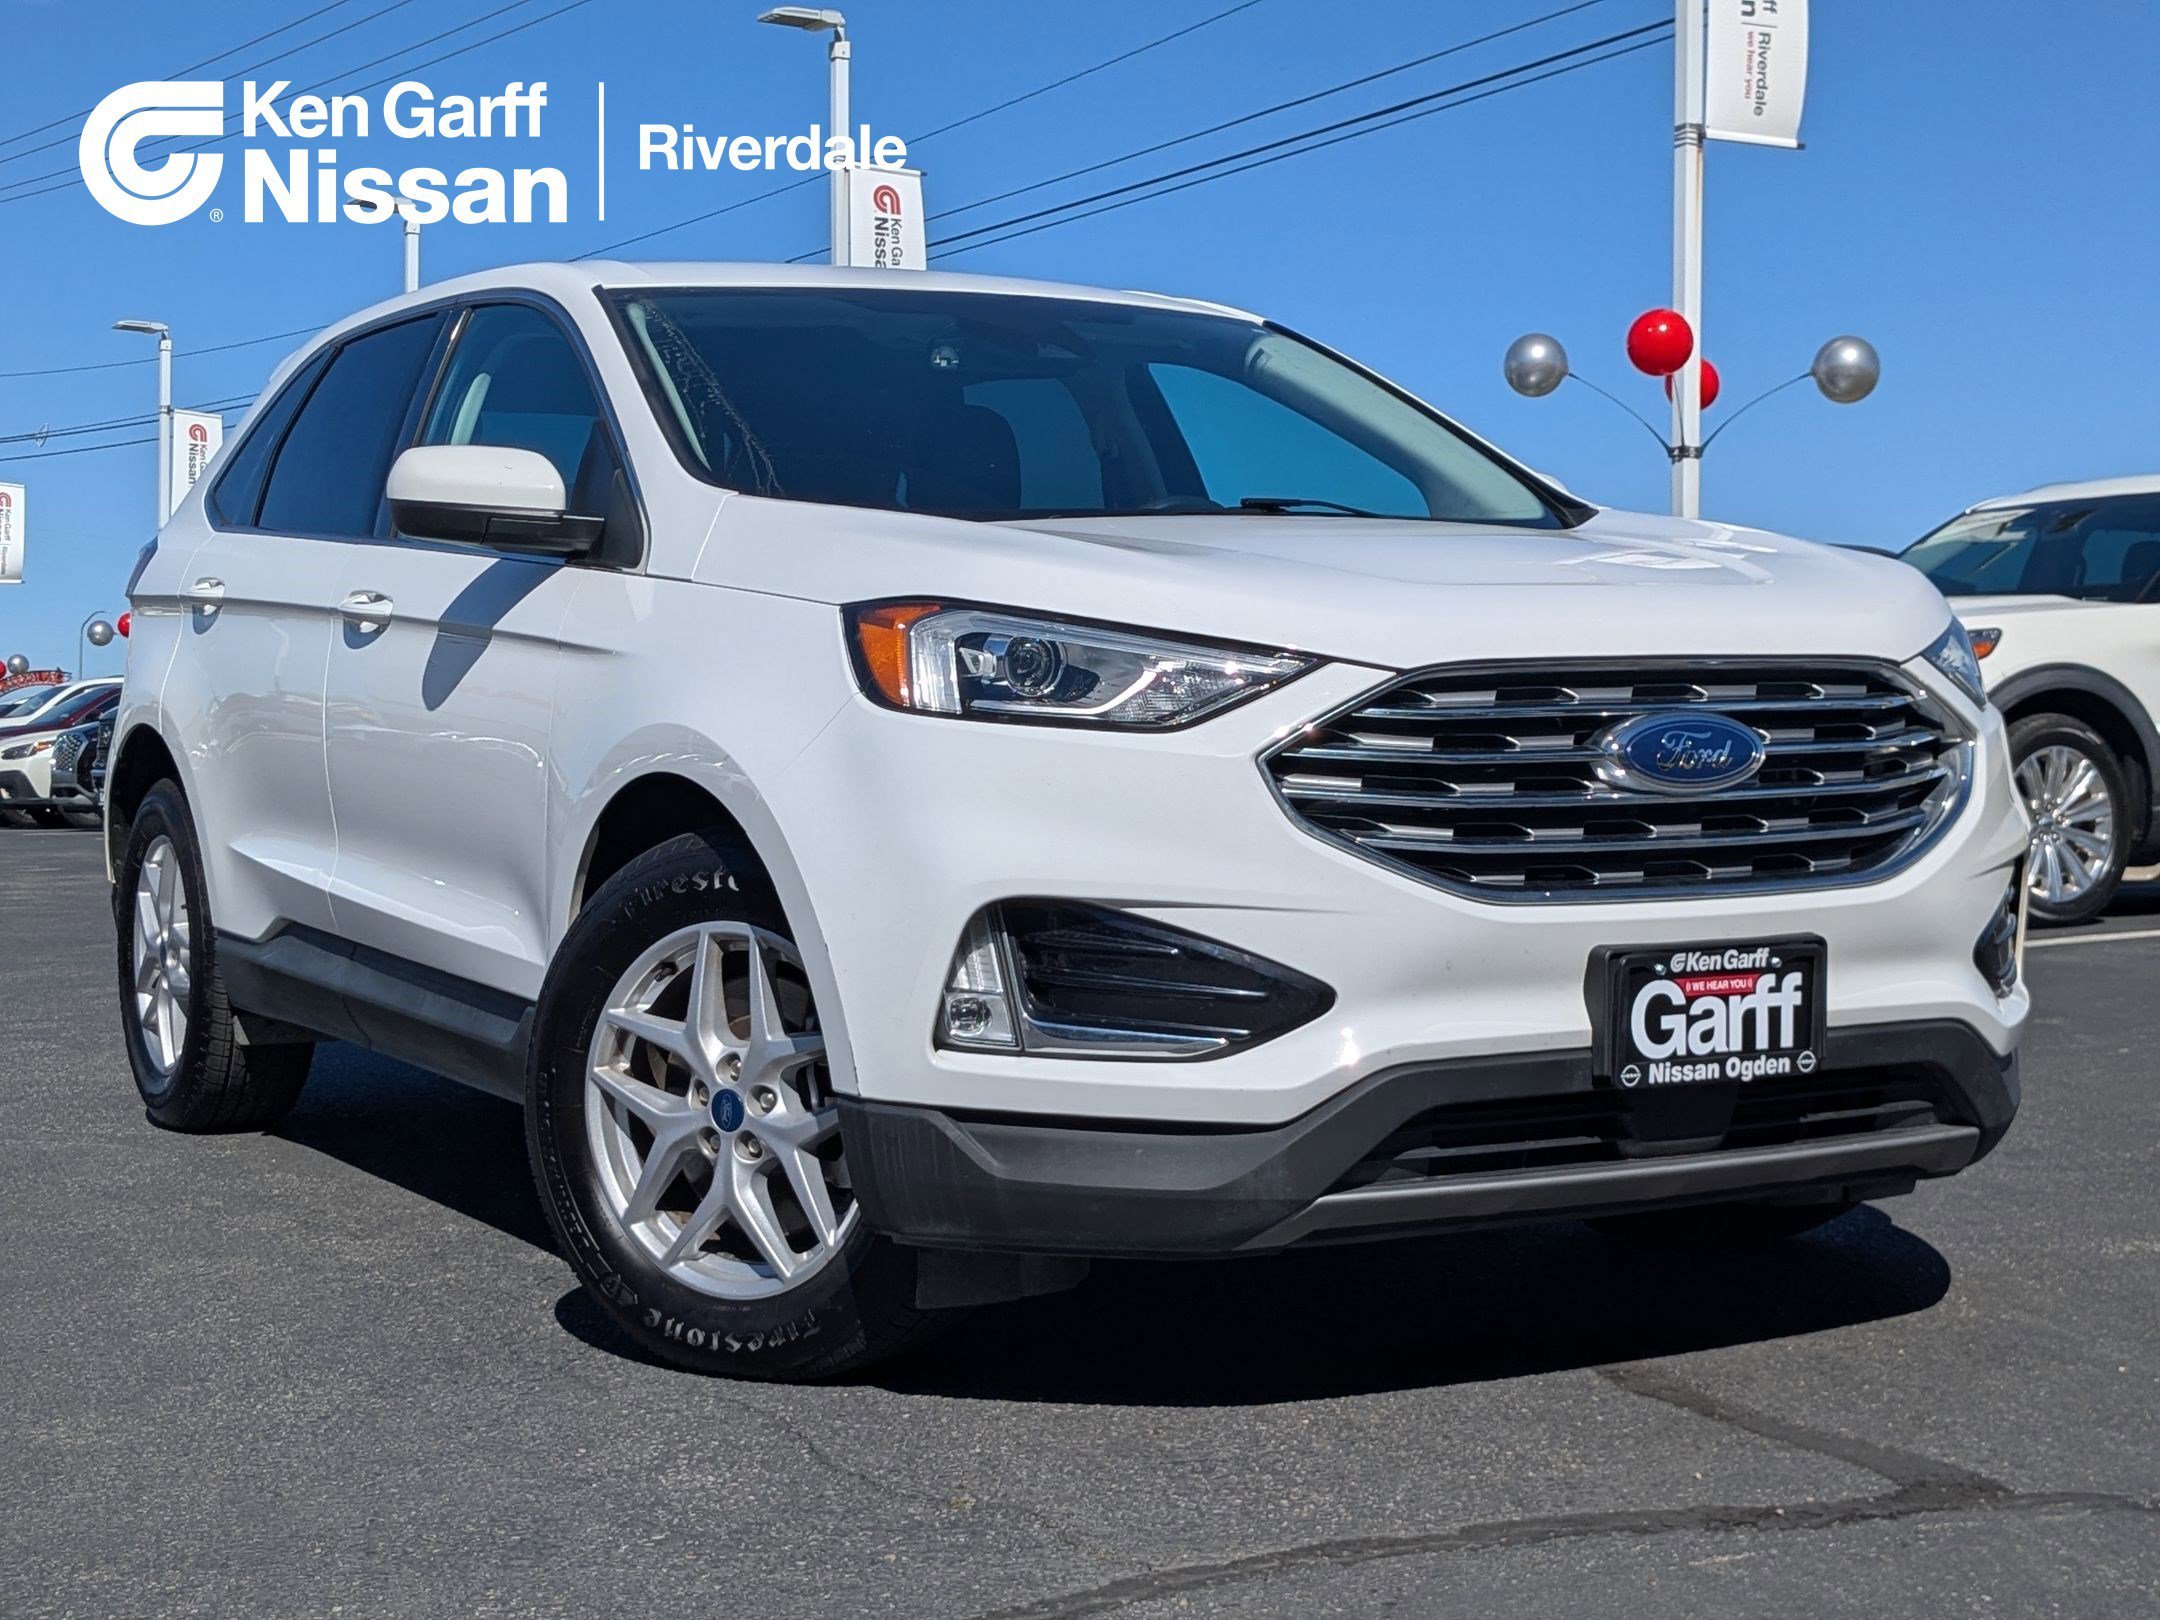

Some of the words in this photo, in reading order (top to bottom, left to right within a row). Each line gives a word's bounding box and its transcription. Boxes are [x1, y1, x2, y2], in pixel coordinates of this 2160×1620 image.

[1753, 32, 1771, 116] Riverdale
[874, 216, 890, 269] Nissa
[890, 218, 903, 245] Ken
[188, 443, 199, 485] Nissan
[1656, 730, 1732, 772] Ford
[1686, 952, 1722, 971] Ken
[1723, 948, 1770, 969] Garff
[1692, 981, 1706, 990] WE
[1706, 980, 1729, 990] HEAR
[1730, 978, 1748, 989] YOU
[1630, 971, 1803, 1060] Garff
[1648, 1061, 1720, 1084] Nissan
[1725, 1055, 1790, 1081] Ogden
[643, 1307, 822, 1352] Firestone
